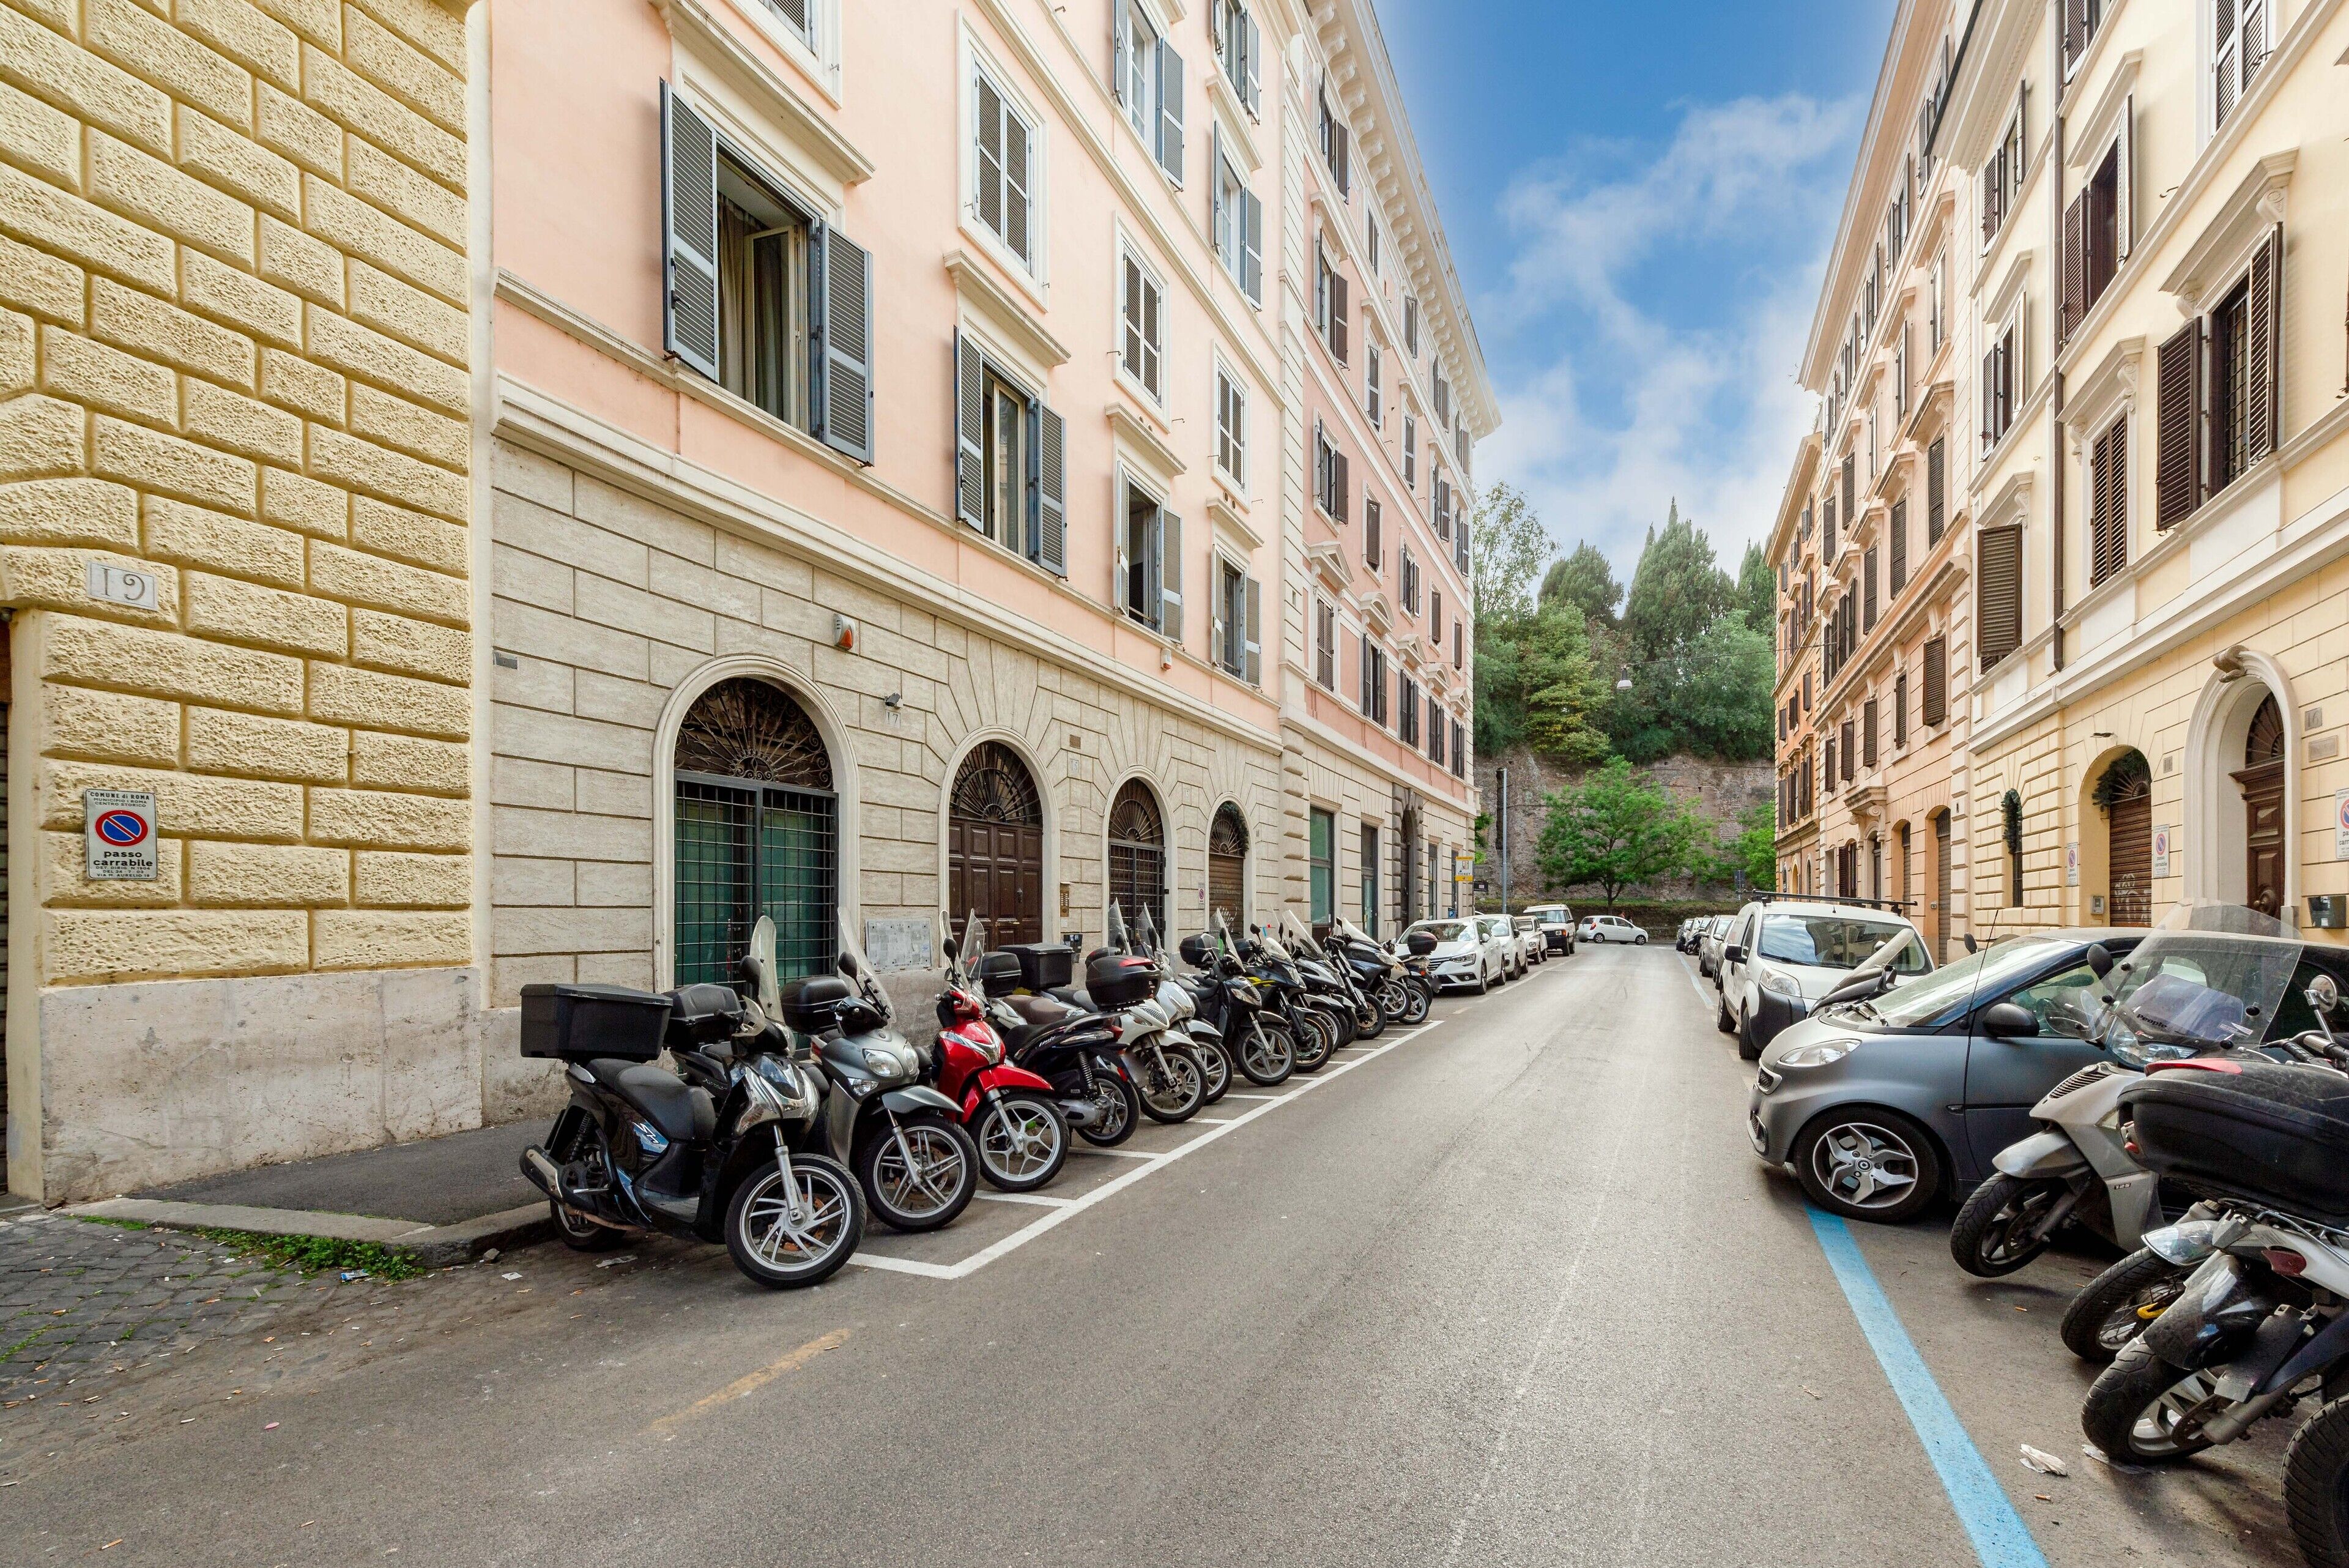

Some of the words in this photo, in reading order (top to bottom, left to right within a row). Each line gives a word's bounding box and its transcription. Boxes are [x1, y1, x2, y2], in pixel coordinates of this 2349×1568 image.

[101, 567, 146, 601] 19
[887, 711, 899, 725] 17
[2308, 710, 2320, 727] 16
[2136, 1013, 2167, 1029] People
